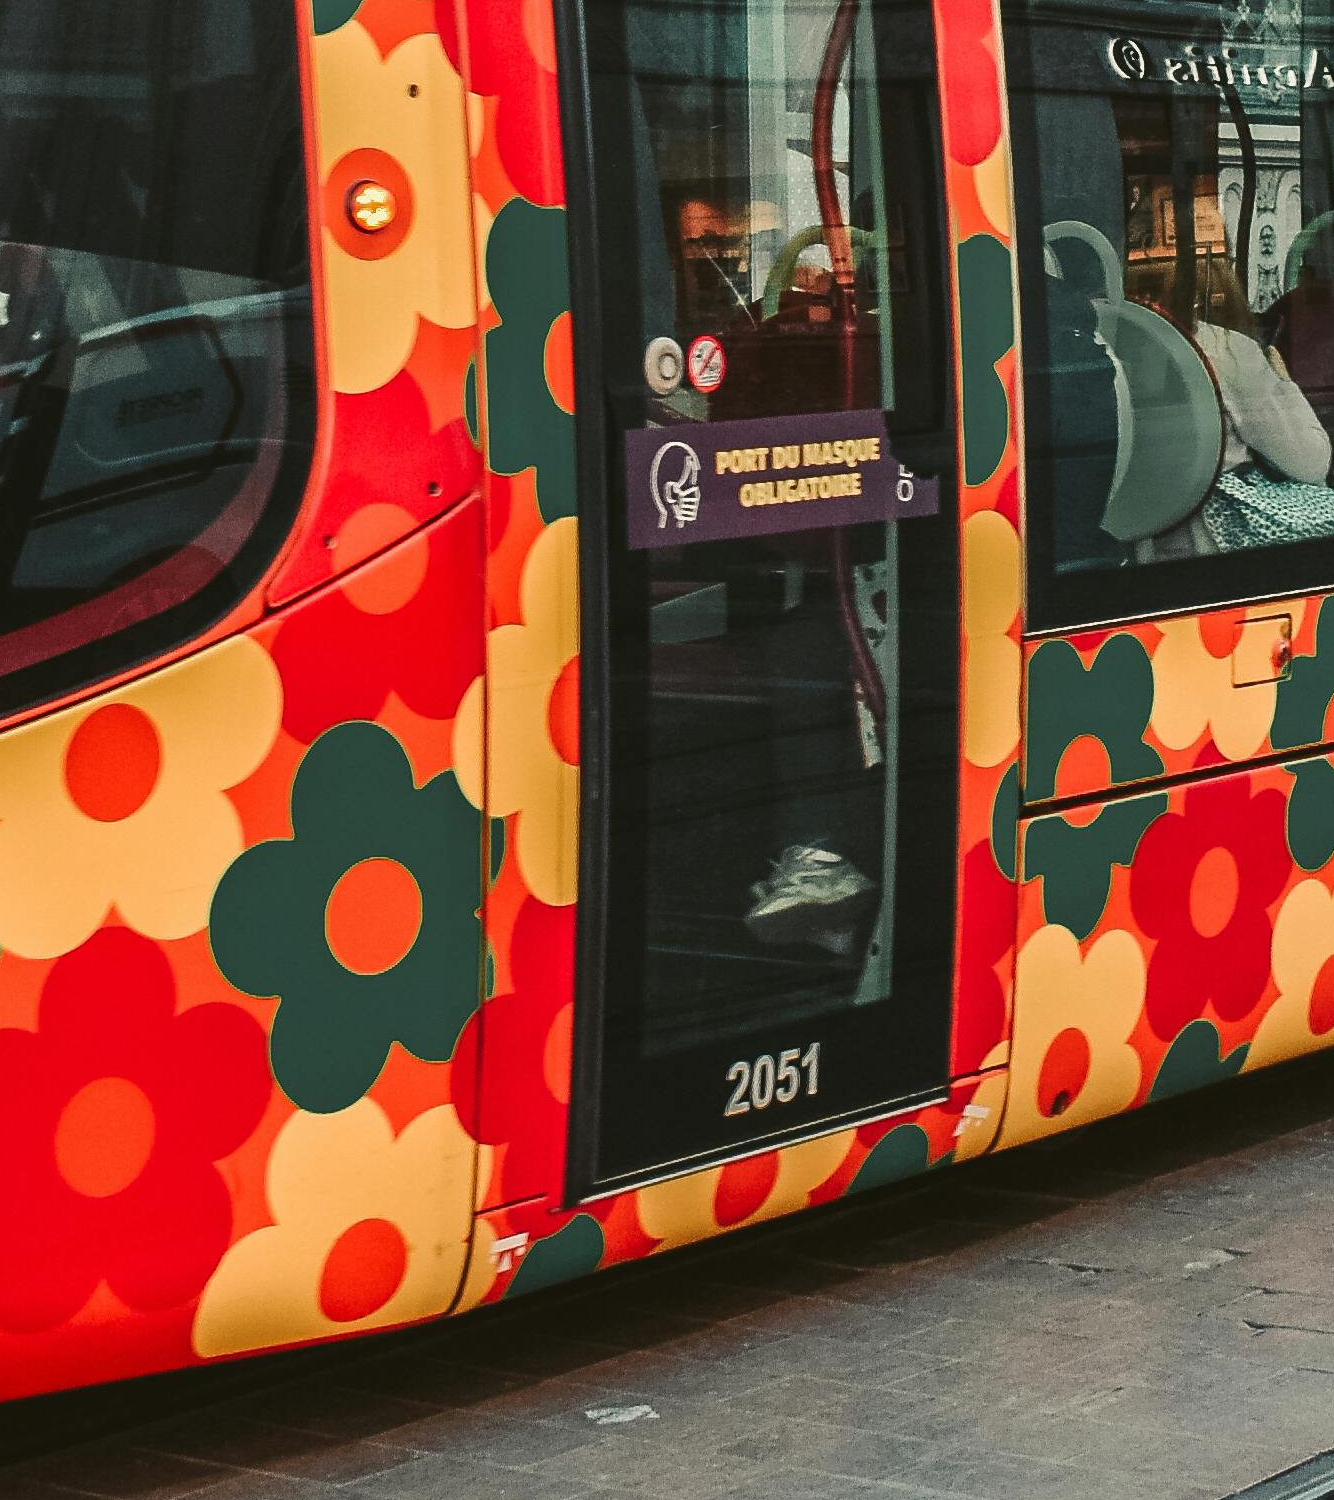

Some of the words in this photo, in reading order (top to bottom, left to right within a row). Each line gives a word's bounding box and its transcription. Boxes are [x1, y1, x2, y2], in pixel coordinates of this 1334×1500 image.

[715, 447, 769, 475] PORT
[772, 444, 801, 470] DU
[802, 437, 881, 469] MASQUE
[739, 472, 862, 508] OBLIGATOIRE
[723, 1042, 821, 1118] 2051
